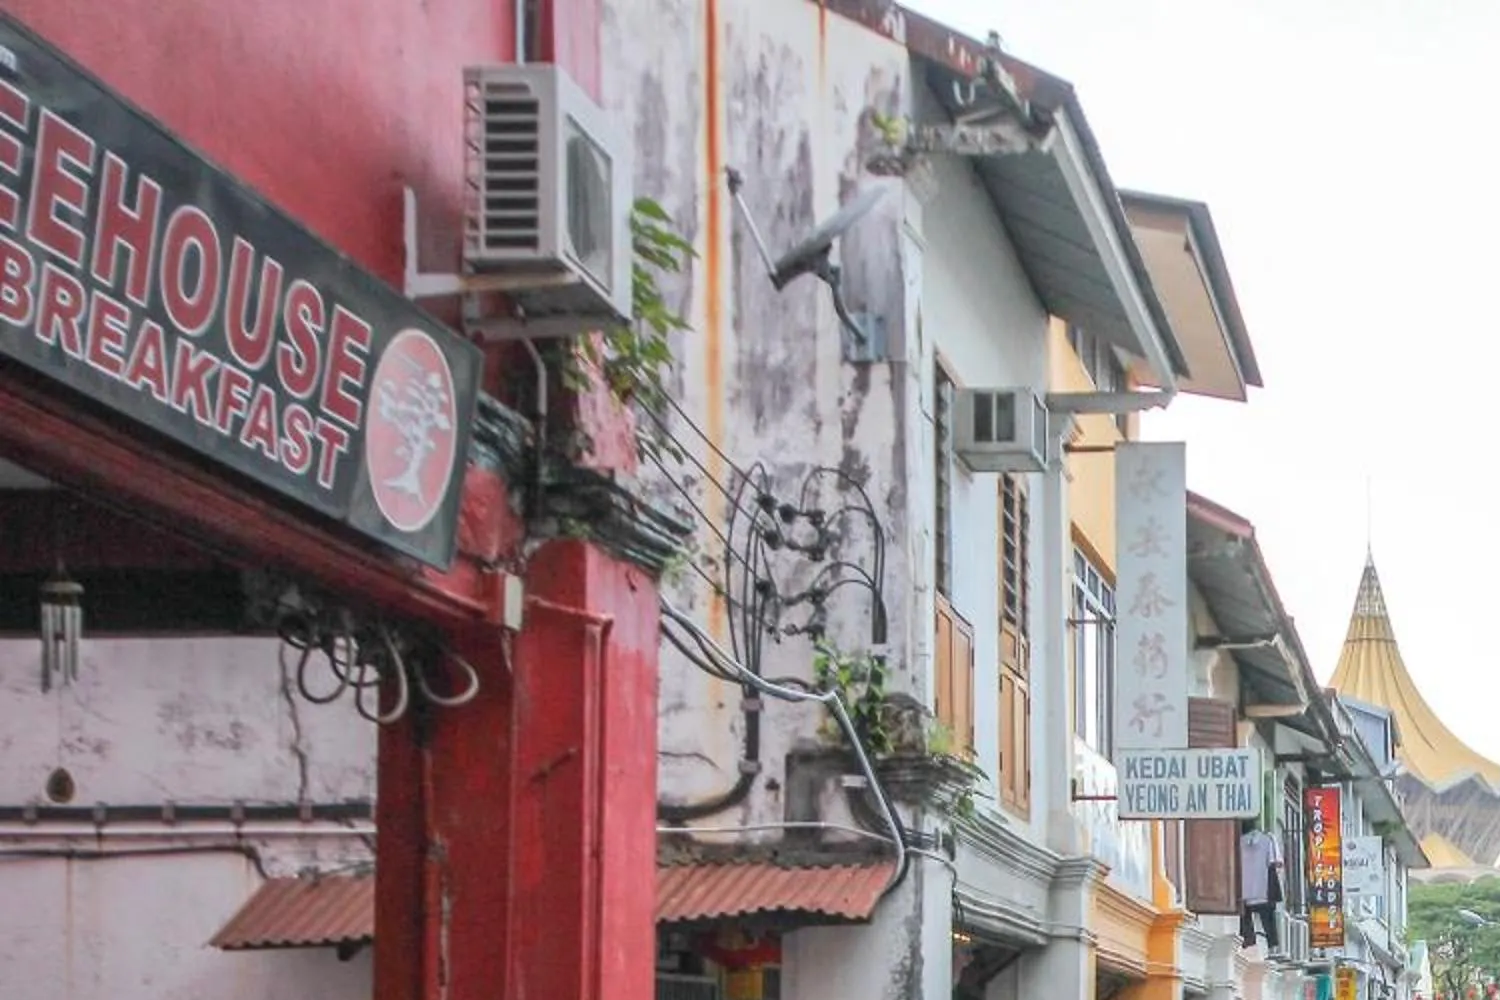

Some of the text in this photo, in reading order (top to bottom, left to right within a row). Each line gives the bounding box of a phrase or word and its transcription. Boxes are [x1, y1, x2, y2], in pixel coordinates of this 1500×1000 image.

[0, 235, 350, 490] BREAKFAST
[1124, 783, 1253, 813] YEONG AN THAI
[1125, 756, 1249, 779] KEDAI UBAT
[1313, 795, 1325, 901] TROPICAL
[1327, 865, 1338, 929] LODGE
